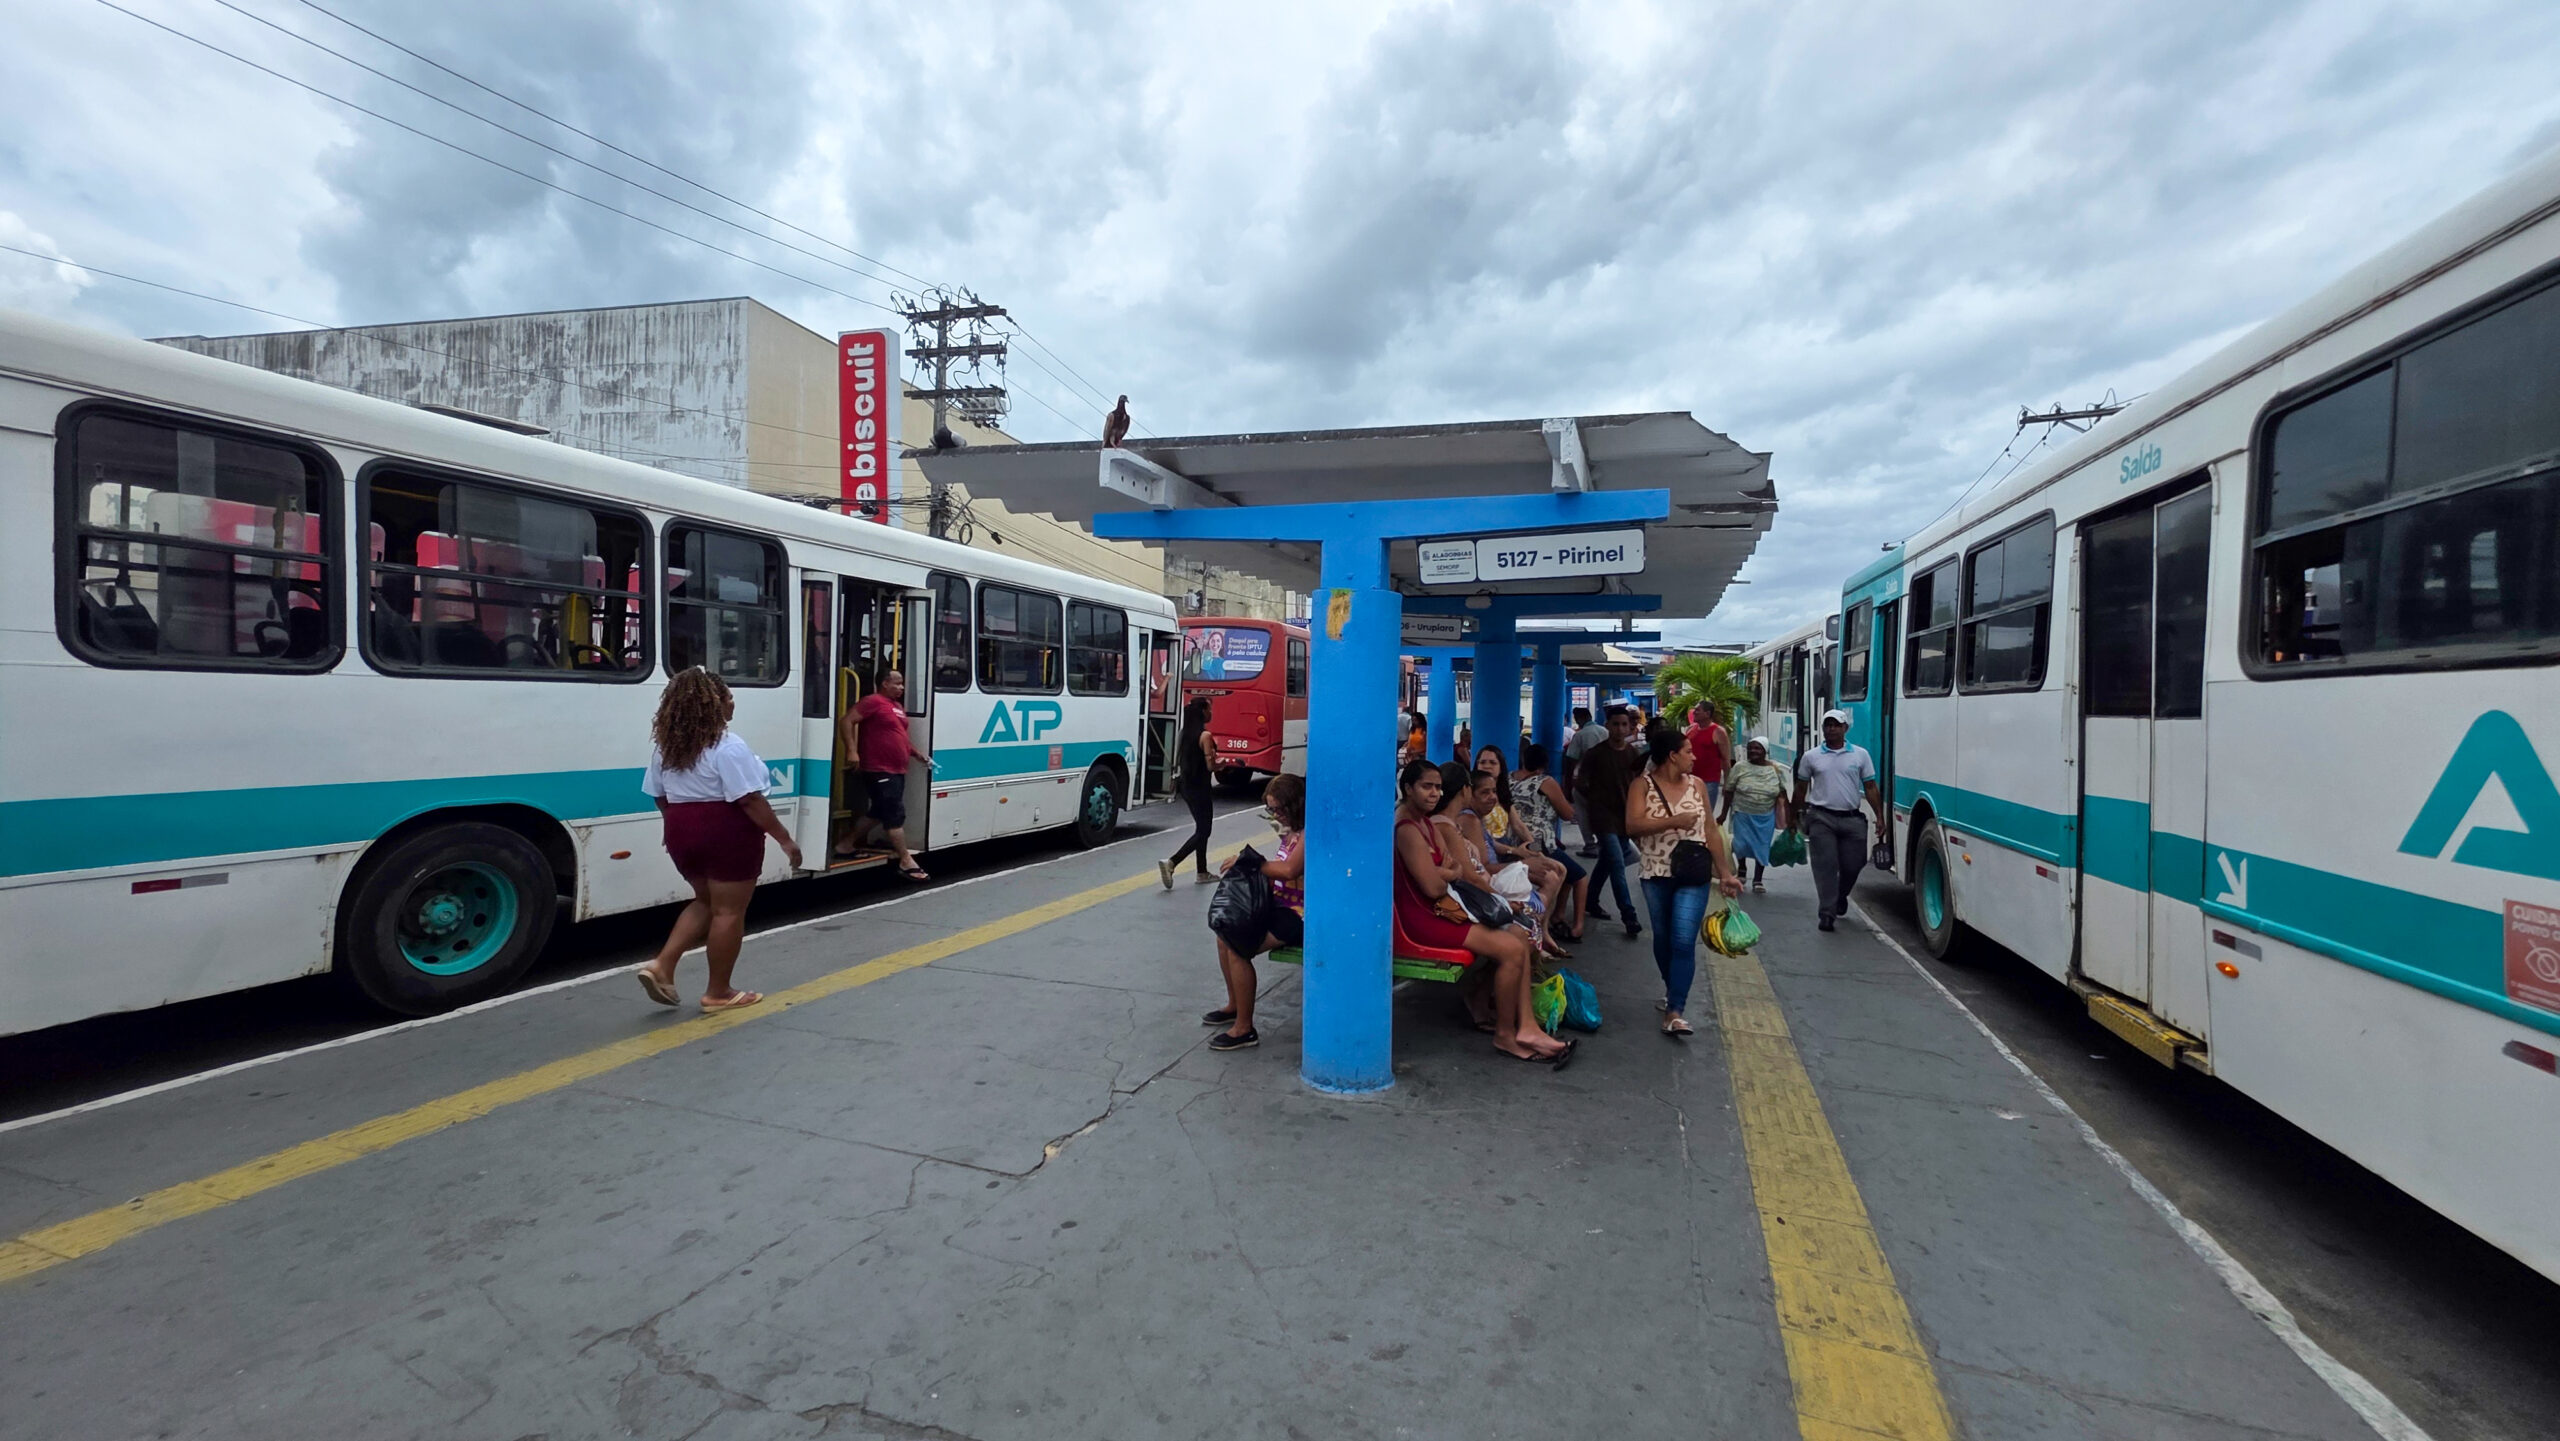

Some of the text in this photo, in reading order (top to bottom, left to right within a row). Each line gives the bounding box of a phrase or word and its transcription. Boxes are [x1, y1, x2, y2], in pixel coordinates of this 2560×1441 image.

[846, 343, 876, 477] biscuit
[2120, 442, 2162, 484] Saída
[1497, 551, 1538, 568] 5127
[1558, 545, 1624, 565] Pirinel
[978, 700, 1063, 744] ATP
[1227, 739, 1248, 749] 3166
